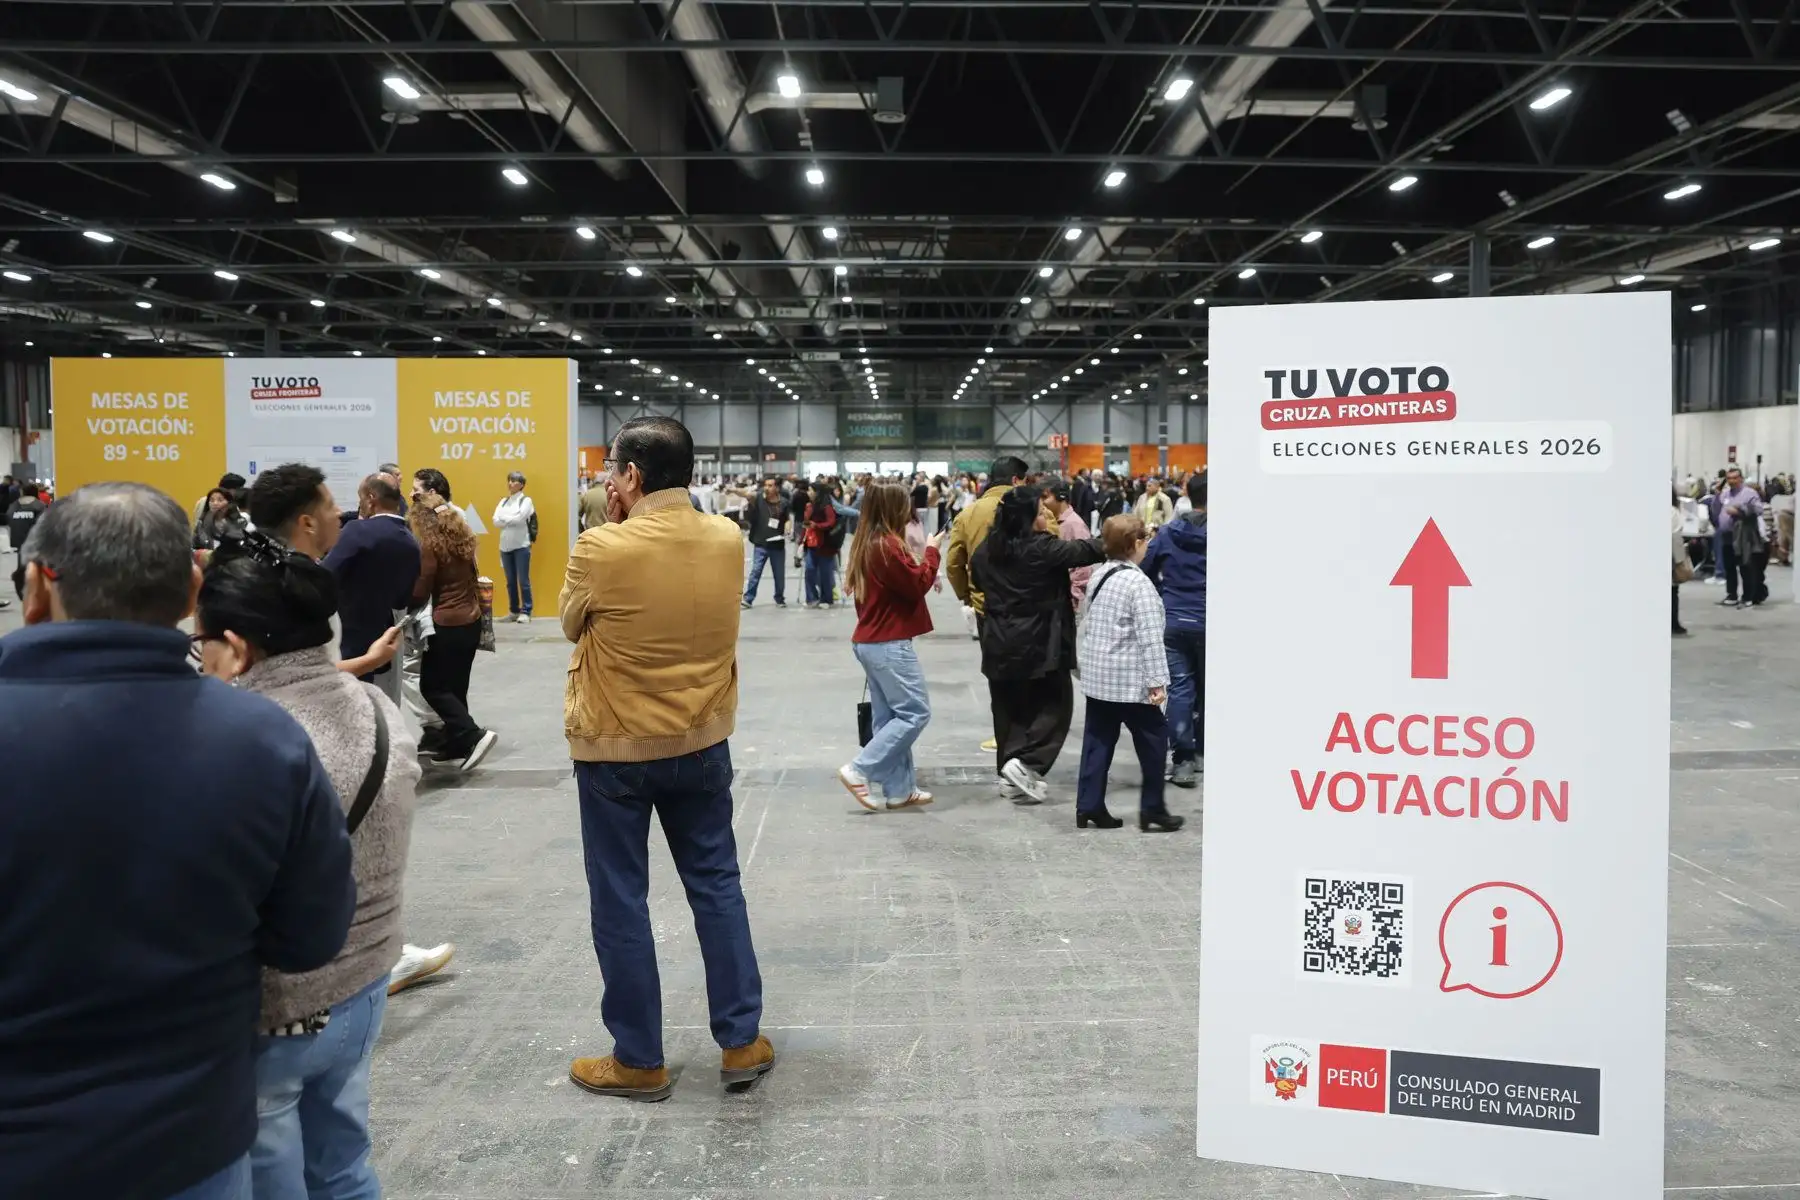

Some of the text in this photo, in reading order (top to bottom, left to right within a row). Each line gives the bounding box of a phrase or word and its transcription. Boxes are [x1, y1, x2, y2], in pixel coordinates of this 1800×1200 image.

[251, 377, 319, 388] TU VOTO
[1264, 366, 1450, 399] TU VOTO
[91, 391, 189, 409] MESAS DE
[350, 403, 372, 411] 2026
[434, 390, 531, 408] MESAS DE
[1269, 399, 1448, 422] CRUZA FRONTERAS
[86, 414, 194, 435] VOTACIÓN:
[429, 413, 536, 434] VOTACIÓN:
[103, 443, 127, 461] 89
[144, 443, 180, 461] 106
[440, 442, 474, 460] 107
[492, 442, 526, 460] 124
[1273, 438, 1601, 457] ELECCIONES GENERALES 2026
[1325, 711, 1535, 760] ACCESO
[1290, 766, 1569, 822] VOTACIÓN
[1326, 1068, 1378, 1089] PERÚ
[1398, 1074, 1581, 1105] CONSULADO GENERAL
[1398, 1091, 1576, 1121] DEL PERÚ EN MADRID
